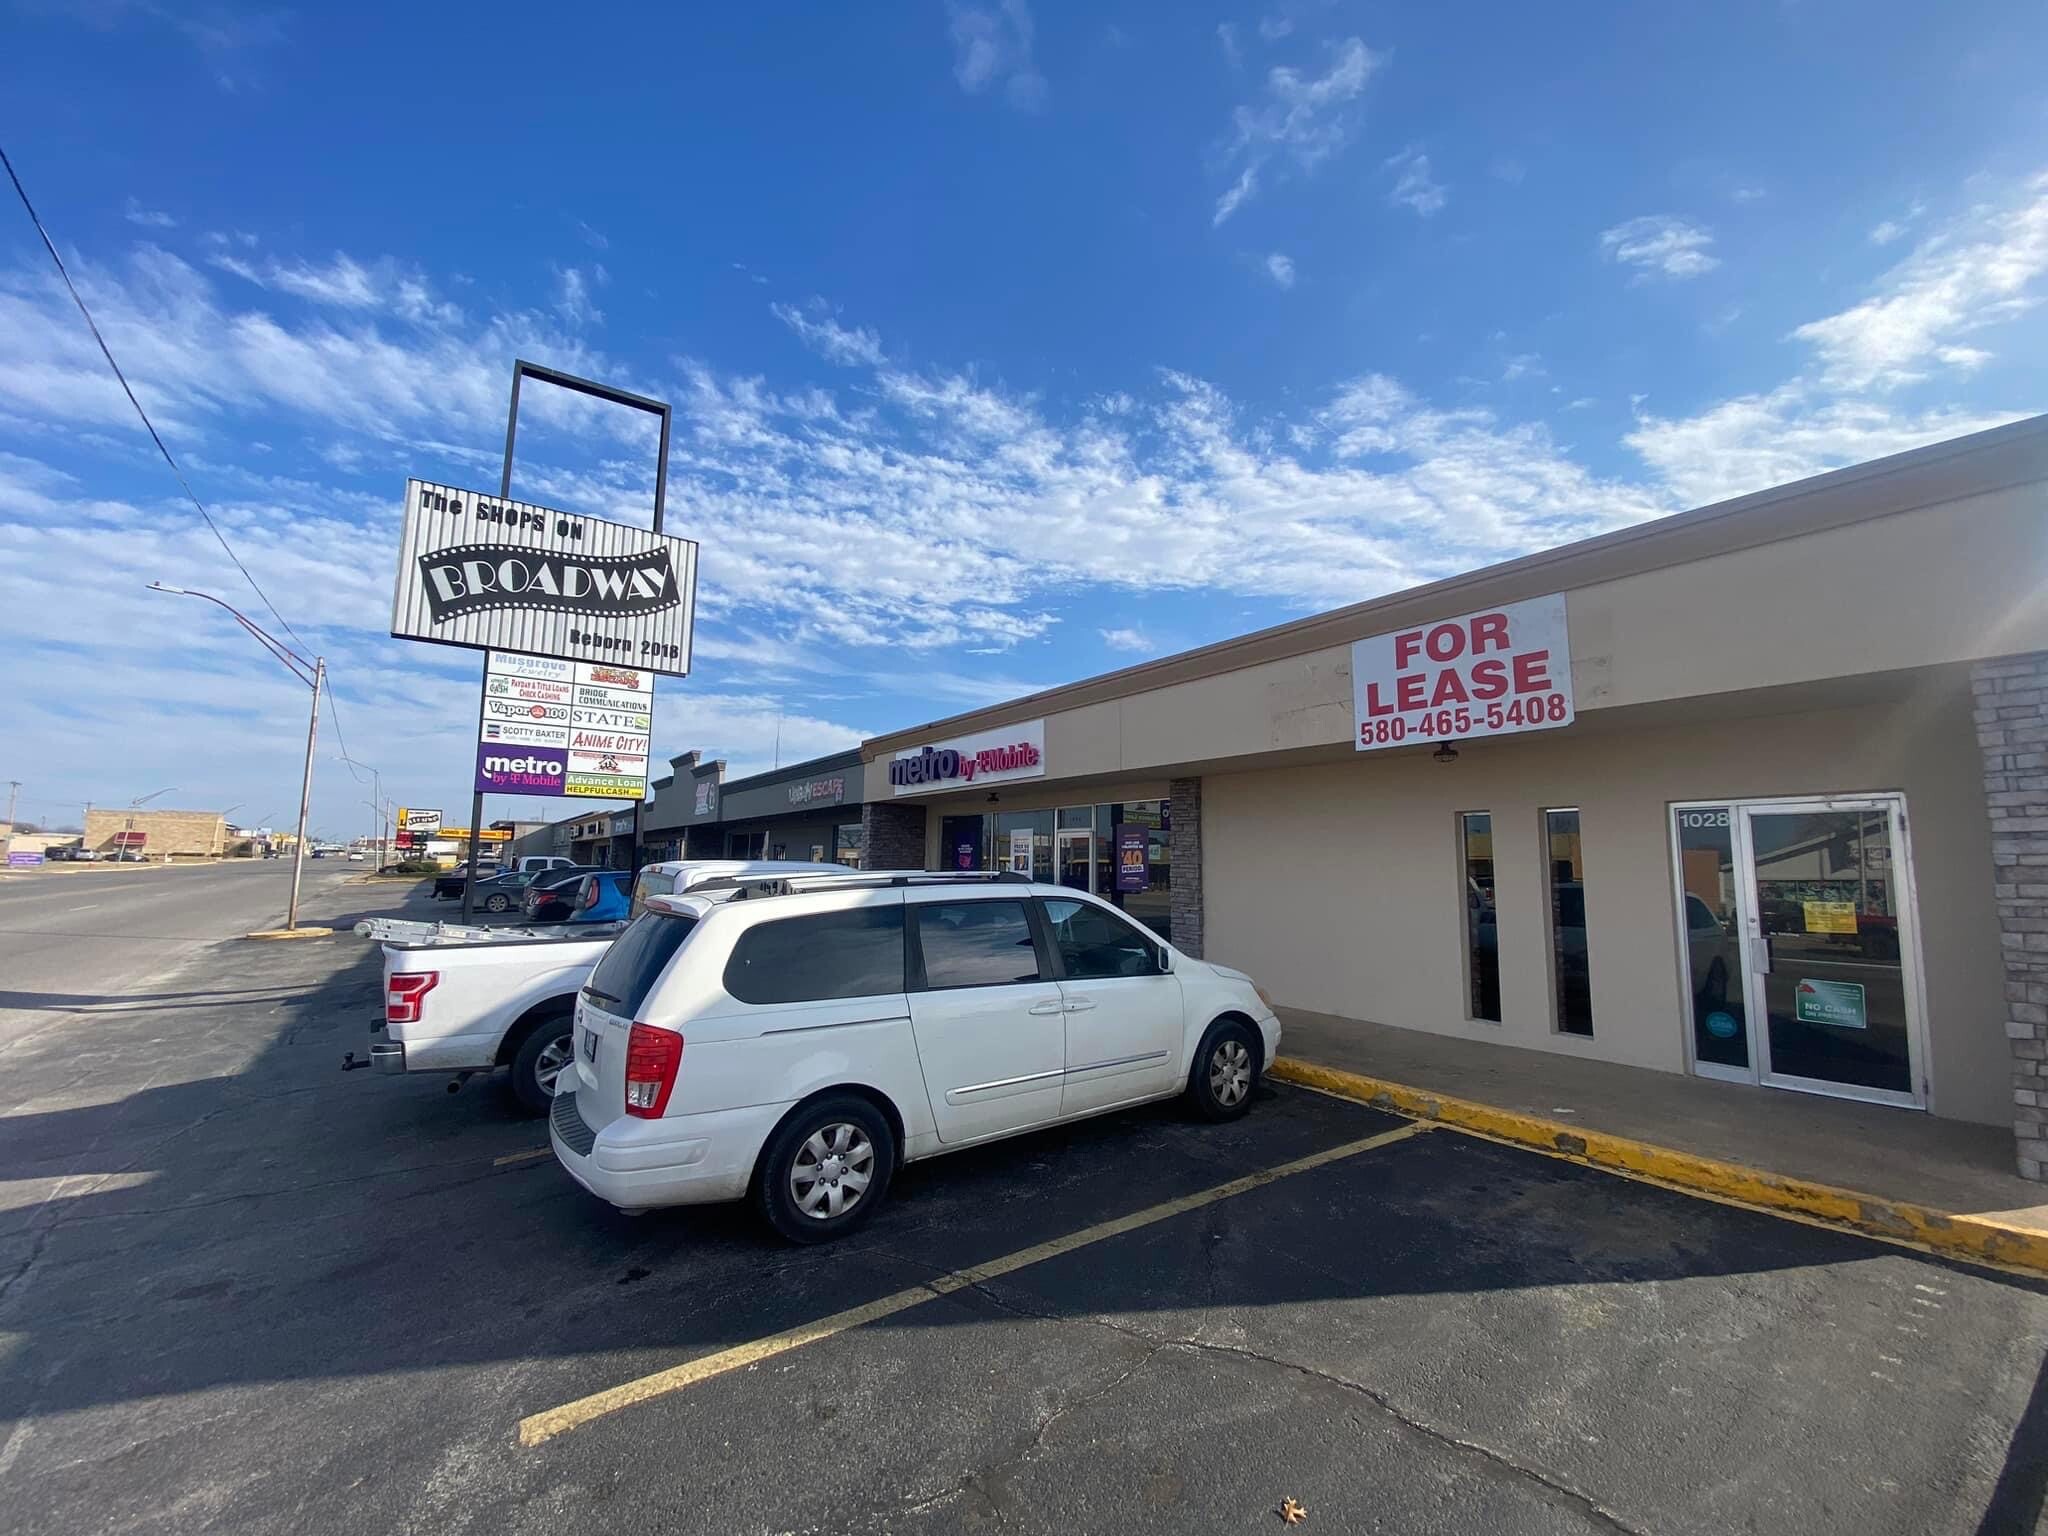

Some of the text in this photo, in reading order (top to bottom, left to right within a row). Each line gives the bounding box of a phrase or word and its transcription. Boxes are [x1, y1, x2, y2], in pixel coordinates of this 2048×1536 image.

[420, 489, 583, 540] The SHOPS ON
[429, 558, 670, 603] BROADWAY
[569, 628, 633, 653] Reborn
[1394, 612, 1511, 671] FOR
[495, 652, 567, 672] Musgrove
[514, 665, 561, 679] Jewelry
[579, 688, 608, 698] BRIDGE
[1366, 649, 1553, 718] LEASE
[489, 701, 567, 720] Vapor 100
[578, 696, 647, 711] COMMUNICATIONS
[572, 709, 634, 728] STATE
[1360, 692, 1567, 746] 580-465-5408
[503, 726, 566, 739] SCOTTY BAXTER
[572, 731, 614, 749] ANIME
[616, 734, 647, 752] CITY!
[484, 756, 562, 776] metro
[888, 746, 960, 786] metro
[959, 756, 976, 781] by
[492, 771, 508, 786] by
[567, 775, 644, 787] Advance Loan
[1679, 812, 1730, 829] 1028
[1804, 1002, 1858, 1016] NO CASH
